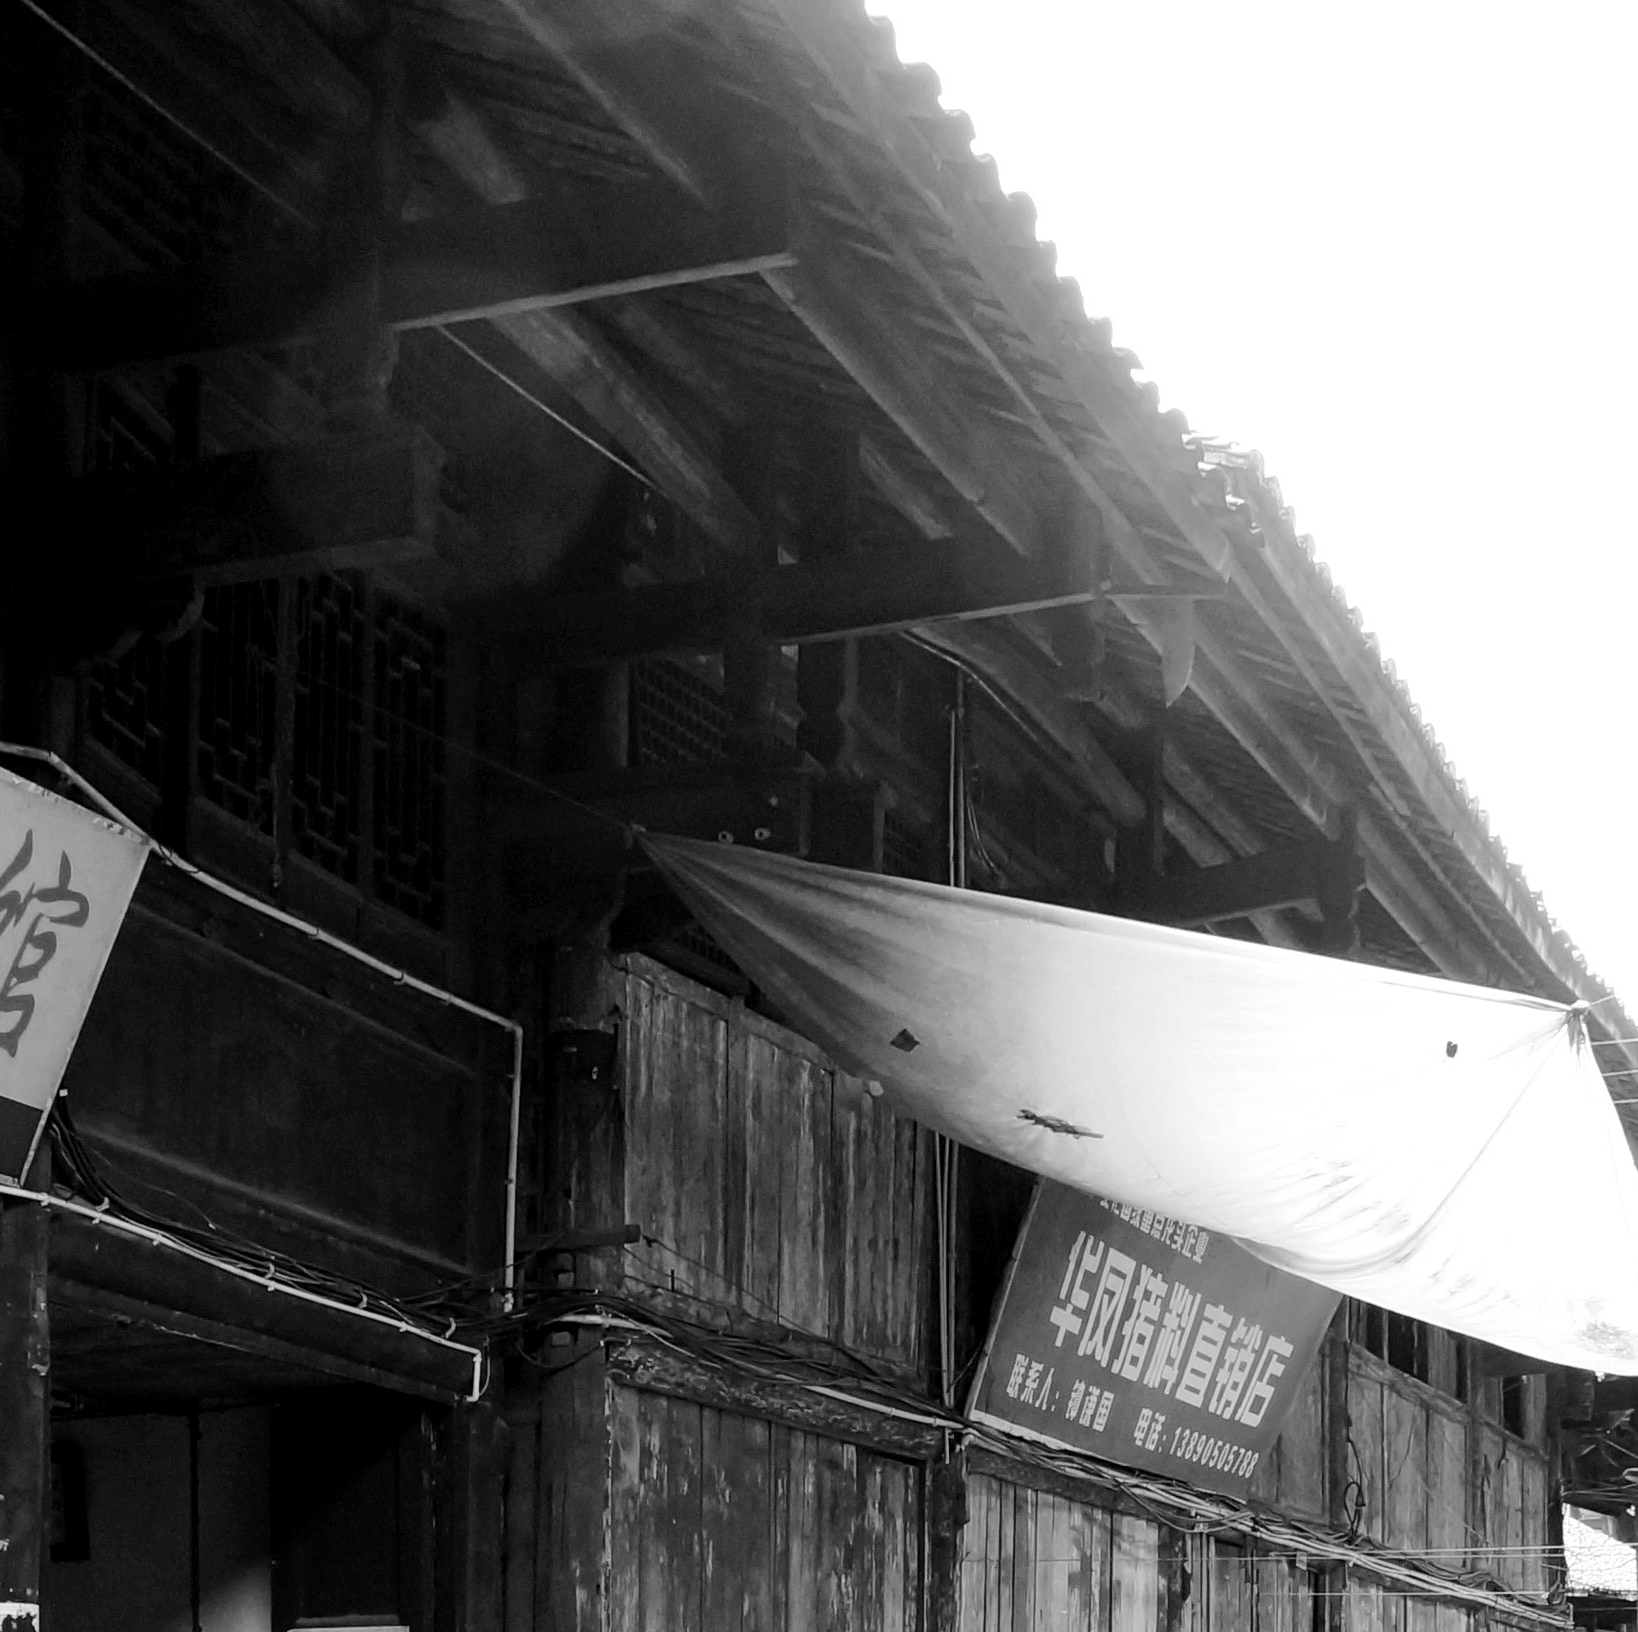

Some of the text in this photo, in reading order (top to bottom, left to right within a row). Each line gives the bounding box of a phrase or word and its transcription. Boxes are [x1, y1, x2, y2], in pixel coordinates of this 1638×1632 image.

[1049, 1230, 1295, 1427] 华凤猪料直销店
